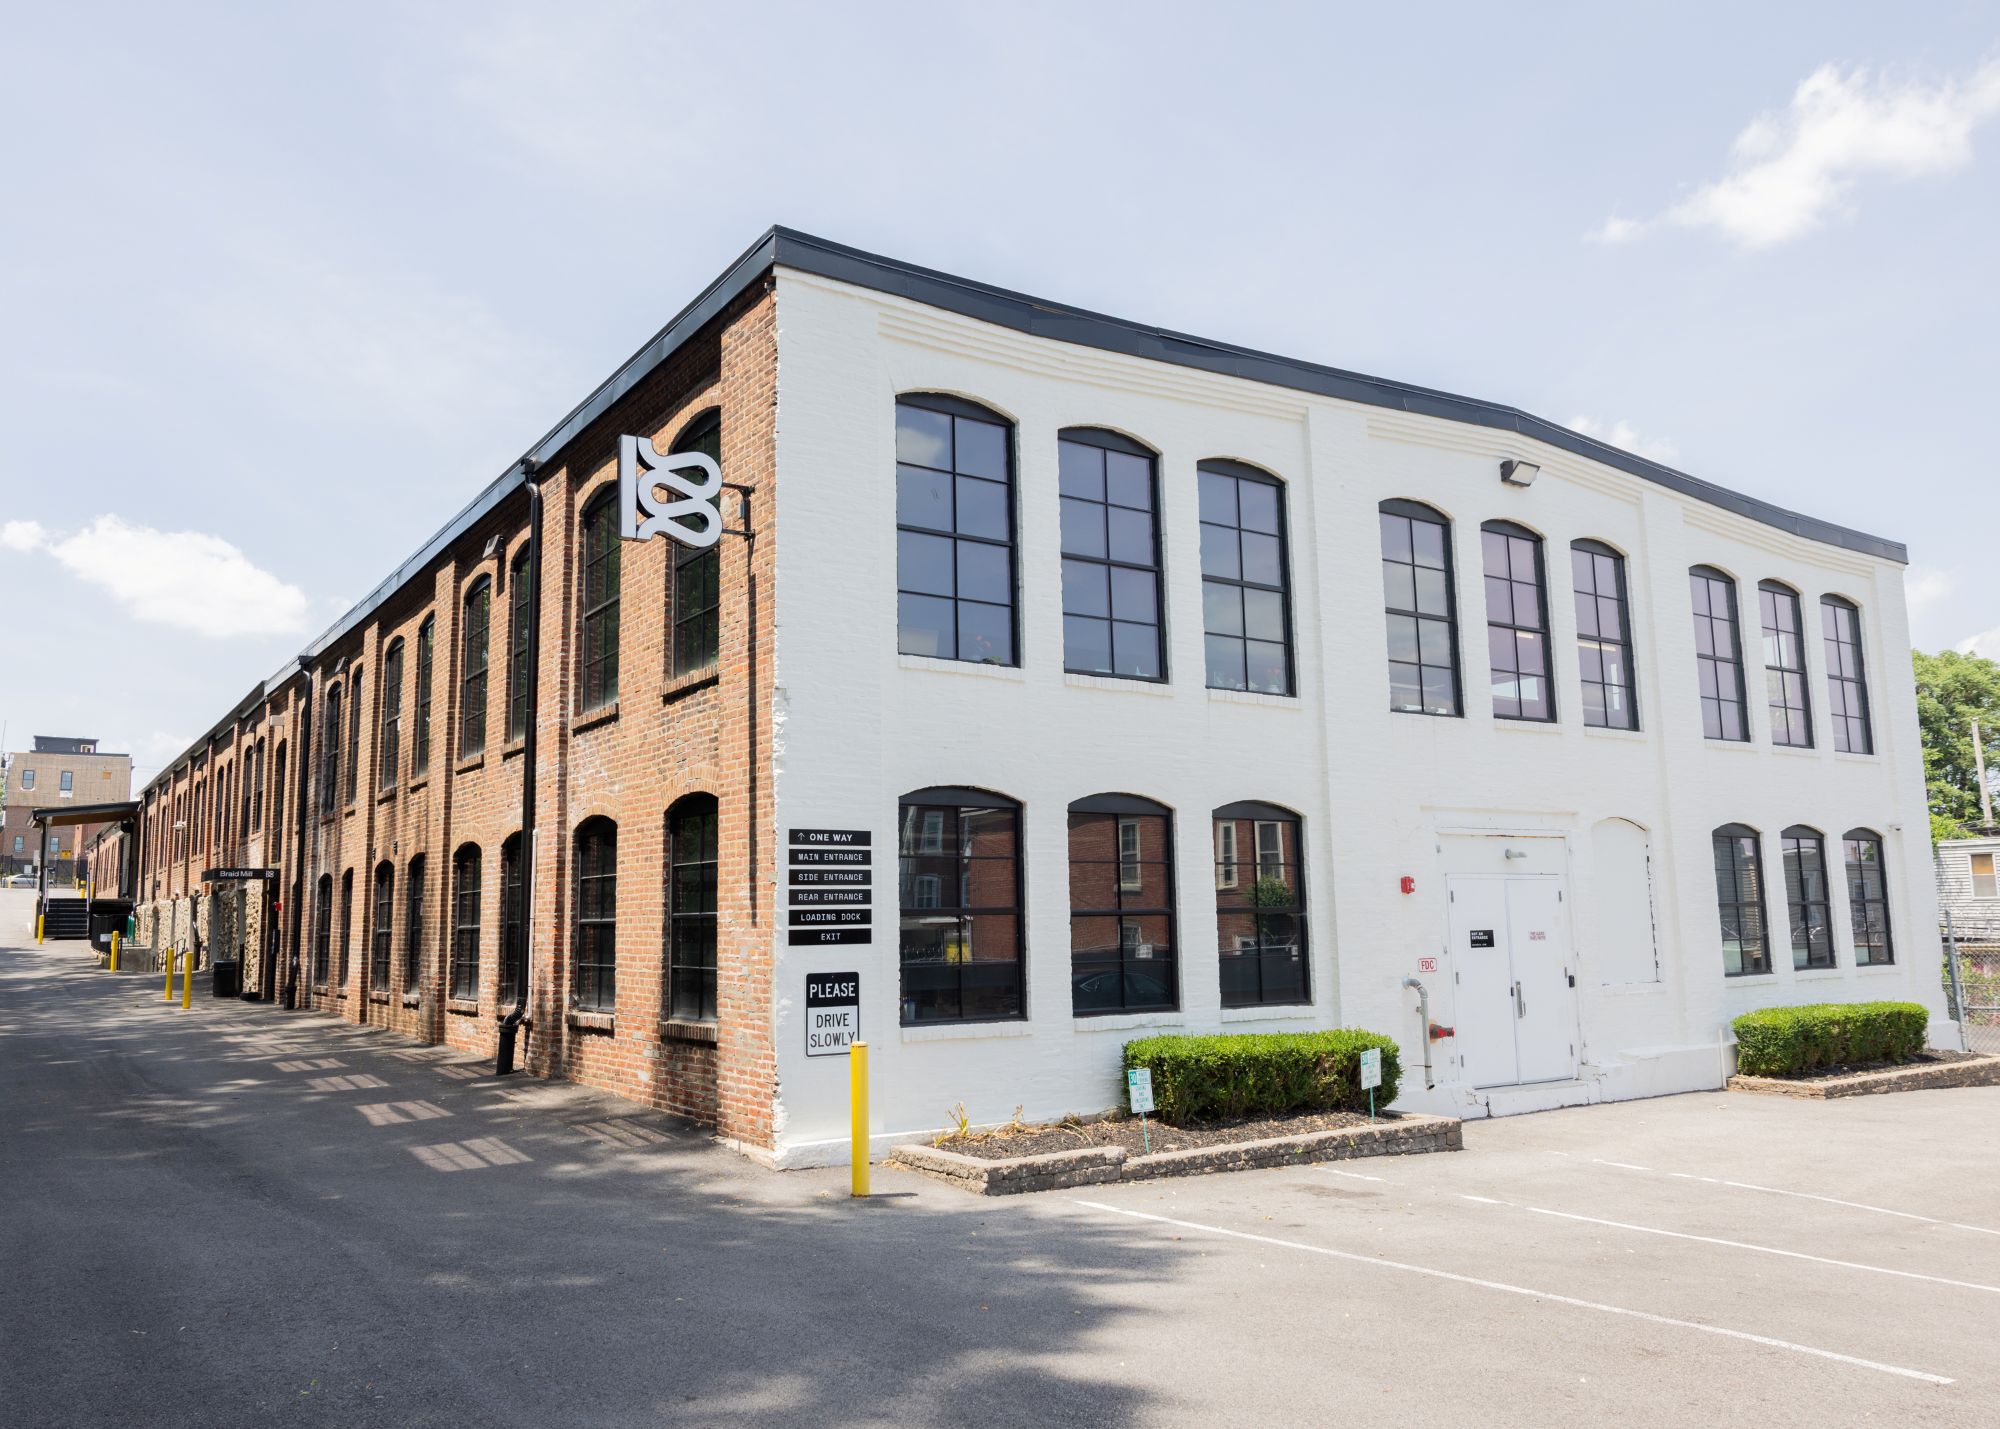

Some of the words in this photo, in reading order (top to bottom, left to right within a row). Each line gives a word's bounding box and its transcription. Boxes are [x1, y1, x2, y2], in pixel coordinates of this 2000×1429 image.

[809, 833, 830, 841] ONE
[832, 833, 853, 842] WAY
[798, 853, 819, 861] MAIN
[823, 853, 863, 861] ENTRANCE
[798, 873, 819, 881] SIDE
[823, 873, 863, 881] ENTRANCE
[798, 893, 819, 901] REAR
[823, 892, 863, 901] ENTRANCE
[800, 913, 837, 921] LOADING
[841, 912, 861, 921] DOCK
[820, 932, 841, 941] EXIT
[1421, 960, 1434, 970] FDC
[809, 982, 856, 999] PLEASE
[816, 1012, 850, 1028] DRIVE
[810, 1031, 855, 1048] SLOWLY
